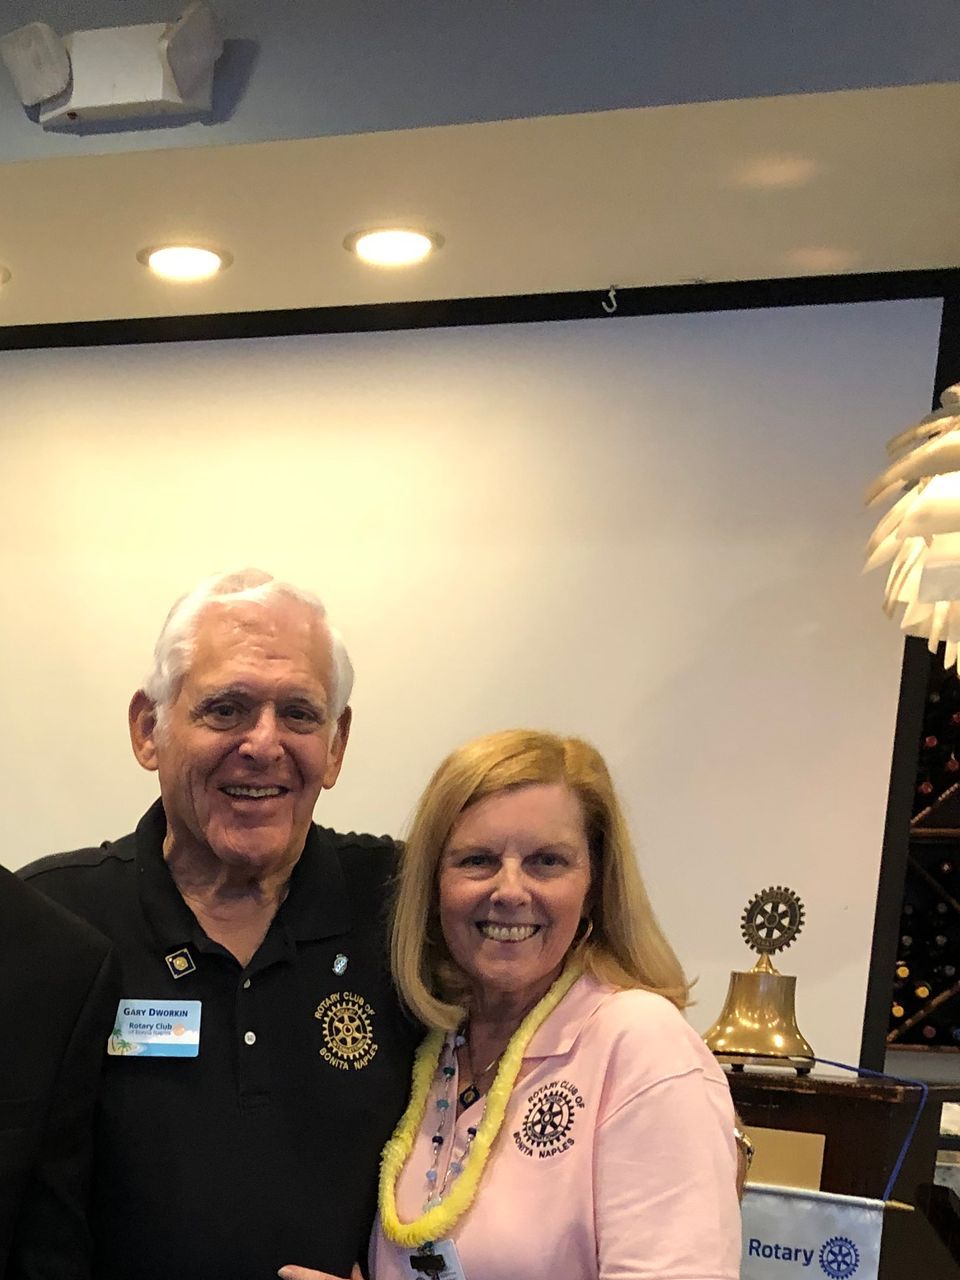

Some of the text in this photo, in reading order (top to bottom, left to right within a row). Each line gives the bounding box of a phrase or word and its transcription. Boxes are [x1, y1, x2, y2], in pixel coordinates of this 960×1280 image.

[123, 1007, 188, 1017] GARY DWORKIN
[314, 992, 341, 1020] ROTARY
[343, 991, 365, 1006] CLUB
[364, 1004, 376, 1016] OF
[129, 1022, 154, 1030] Rotary
[319, 1047, 349, 1071] BONITA
[354, 1043, 379, 1071] NAPLES
[528, 1081, 559, 1103] ROTARY
[560, 1080, 579, 1096] CLUB
[575, 1096, 585, 1109] OF
[513, 1131, 534, 1157] BONITA
[539, 1138, 575, 1159] NAPLES
[748, 1238, 814, 1267] Rotary
